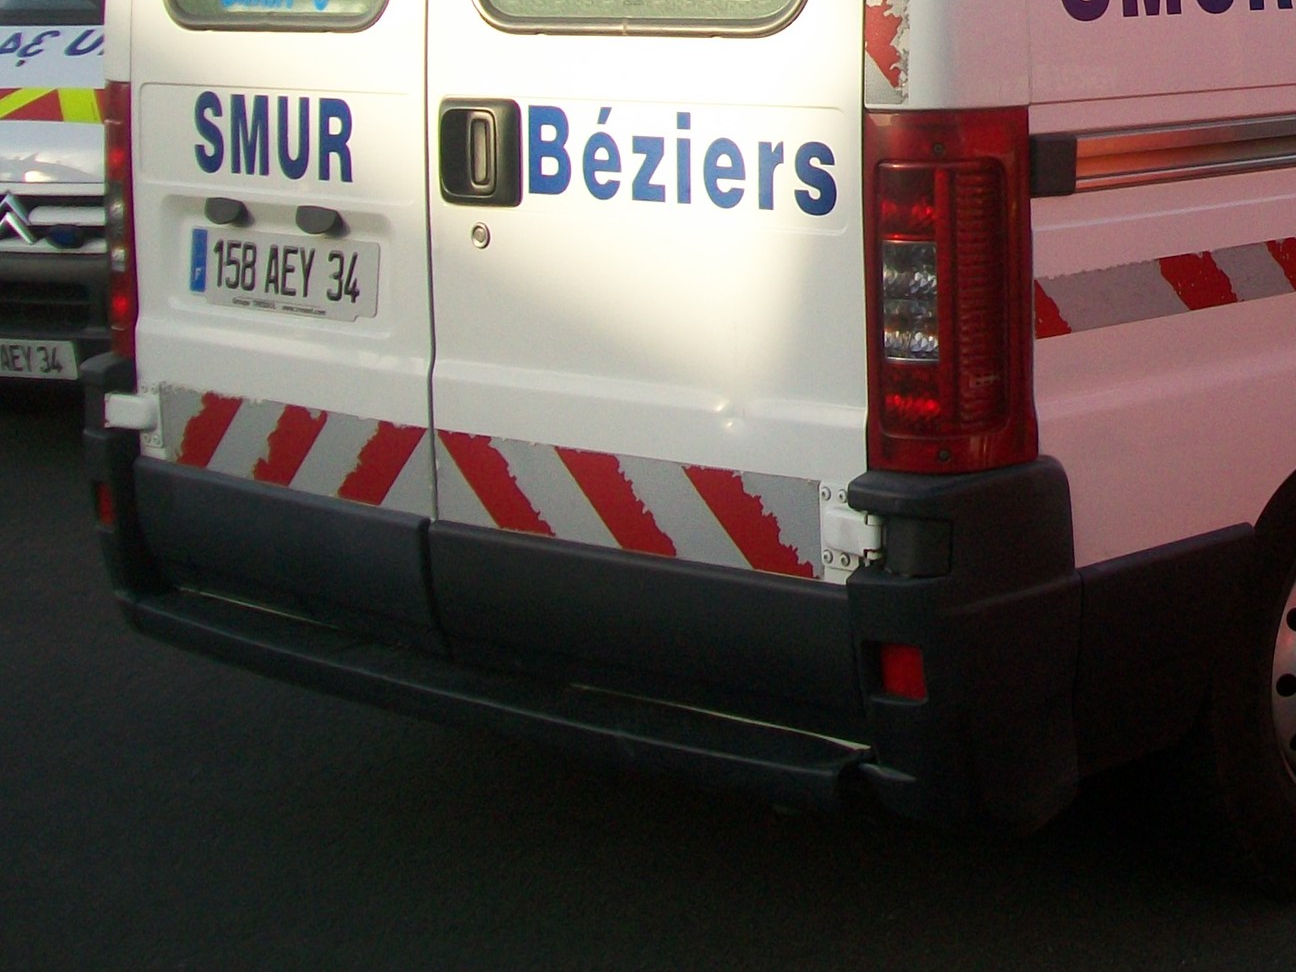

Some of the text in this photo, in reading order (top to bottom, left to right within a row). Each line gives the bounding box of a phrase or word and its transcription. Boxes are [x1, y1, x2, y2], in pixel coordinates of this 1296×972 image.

[194, 90, 838, 217] SMUR Béziers
[213, 238, 361, 304] 158 AEY 34
[0, 344, 63, 373] AEY 34
